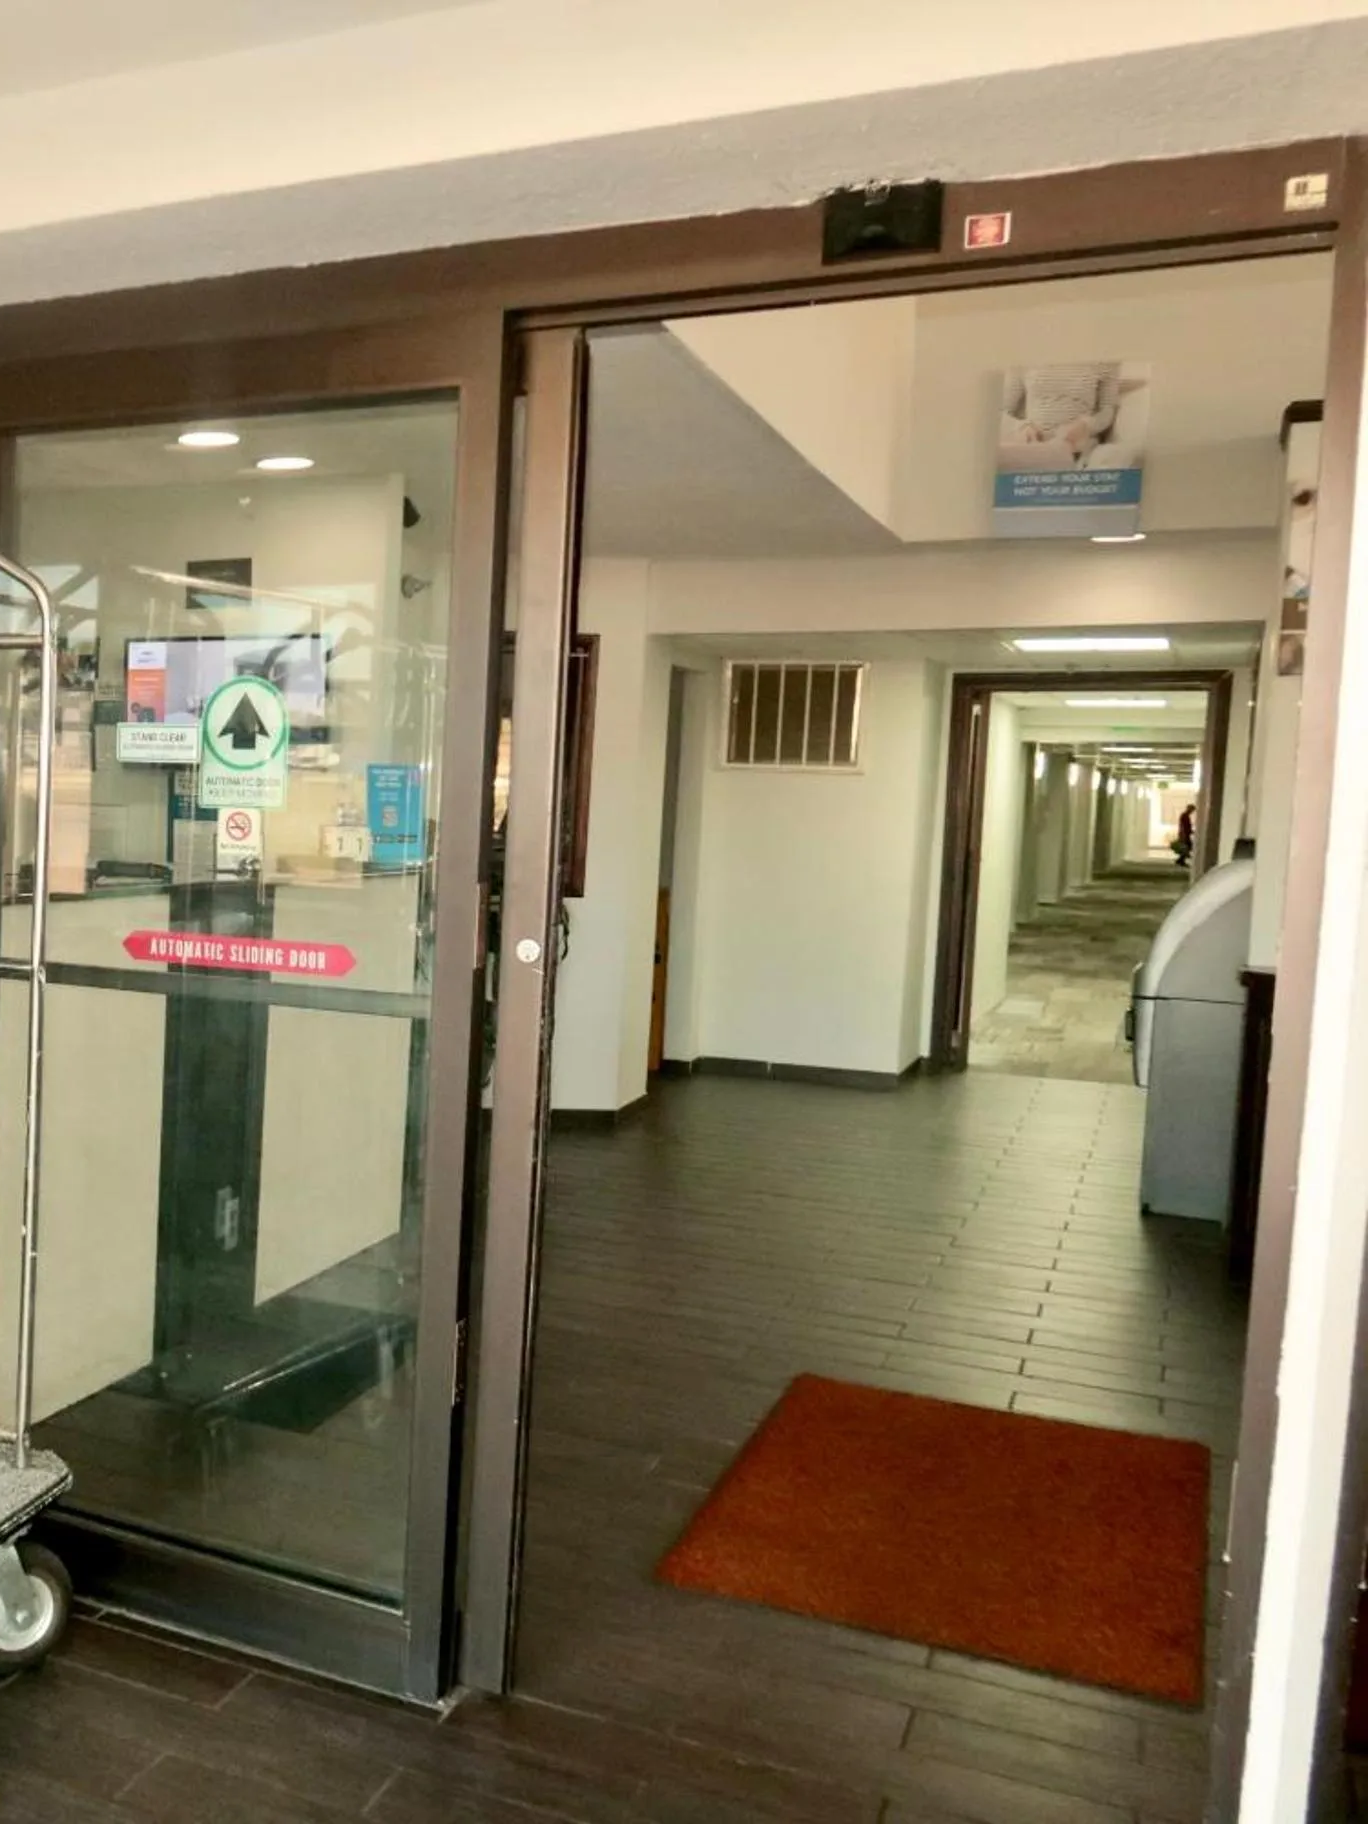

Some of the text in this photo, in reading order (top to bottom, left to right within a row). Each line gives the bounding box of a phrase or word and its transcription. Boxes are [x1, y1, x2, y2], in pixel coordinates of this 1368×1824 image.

[1013, 472, 1121, 485] EXTEND YOUR STAY
[1013, 484, 1118, 497] NOT YOUR BUDGET
[205, 776, 254, 787] AUTOMATIC
[149, 938, 326, 970] AUTOMATIC SLIDING DOOR
